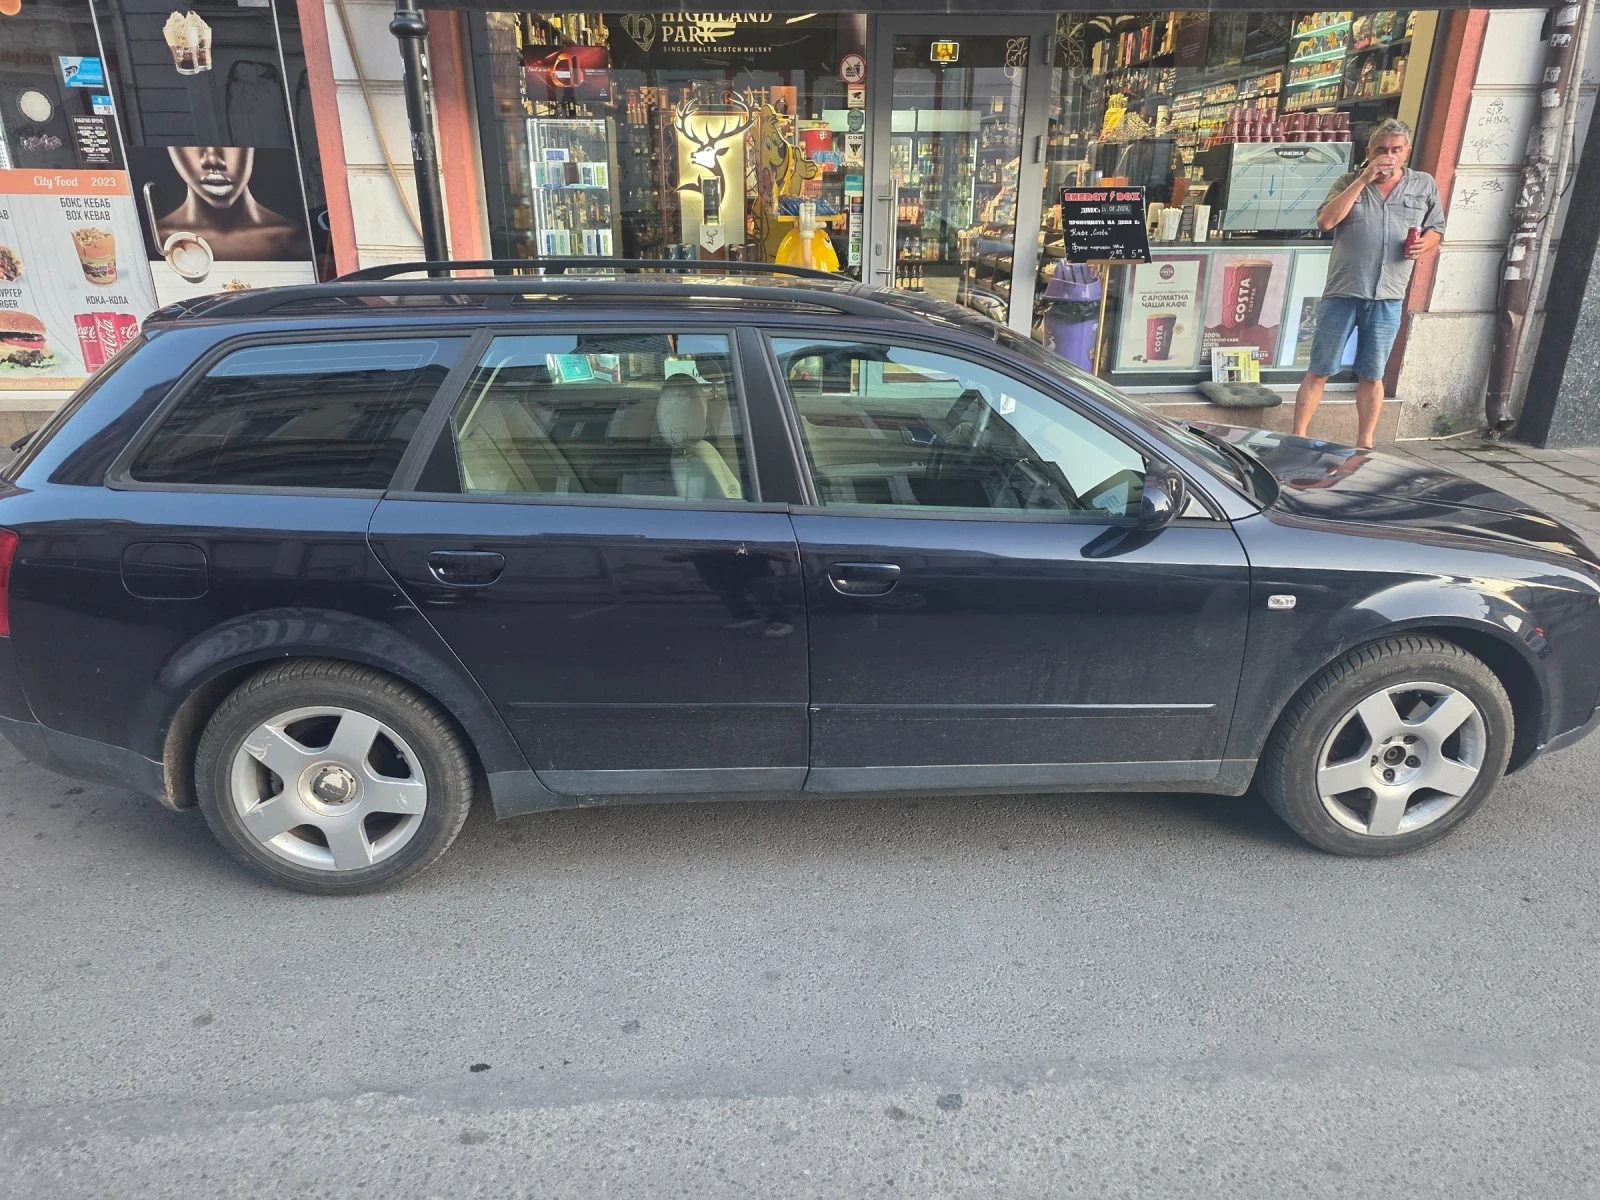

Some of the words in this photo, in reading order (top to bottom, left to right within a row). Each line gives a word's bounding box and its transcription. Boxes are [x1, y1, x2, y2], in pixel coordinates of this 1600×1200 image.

[662, 26, 717, 45] PARK
[34, 175, 53, 189] City
[54, 176, 79, 187] Food
[91, 177, 117, 187] 2023
[60, 197, 82, 208] БОКС
[84, 198, 111, 208] КЕБАБ
[1064, 192, 1108, 201] ENERGY
[1116, 192, 1141, 201] BOX
[66, 210, 83, 221] BOX
[85, 295, 129, 305] КОКА-КОЛА
[1235, 278, 1251, 322] COSTA
[1155, 325, 1164, 352] COSTA
